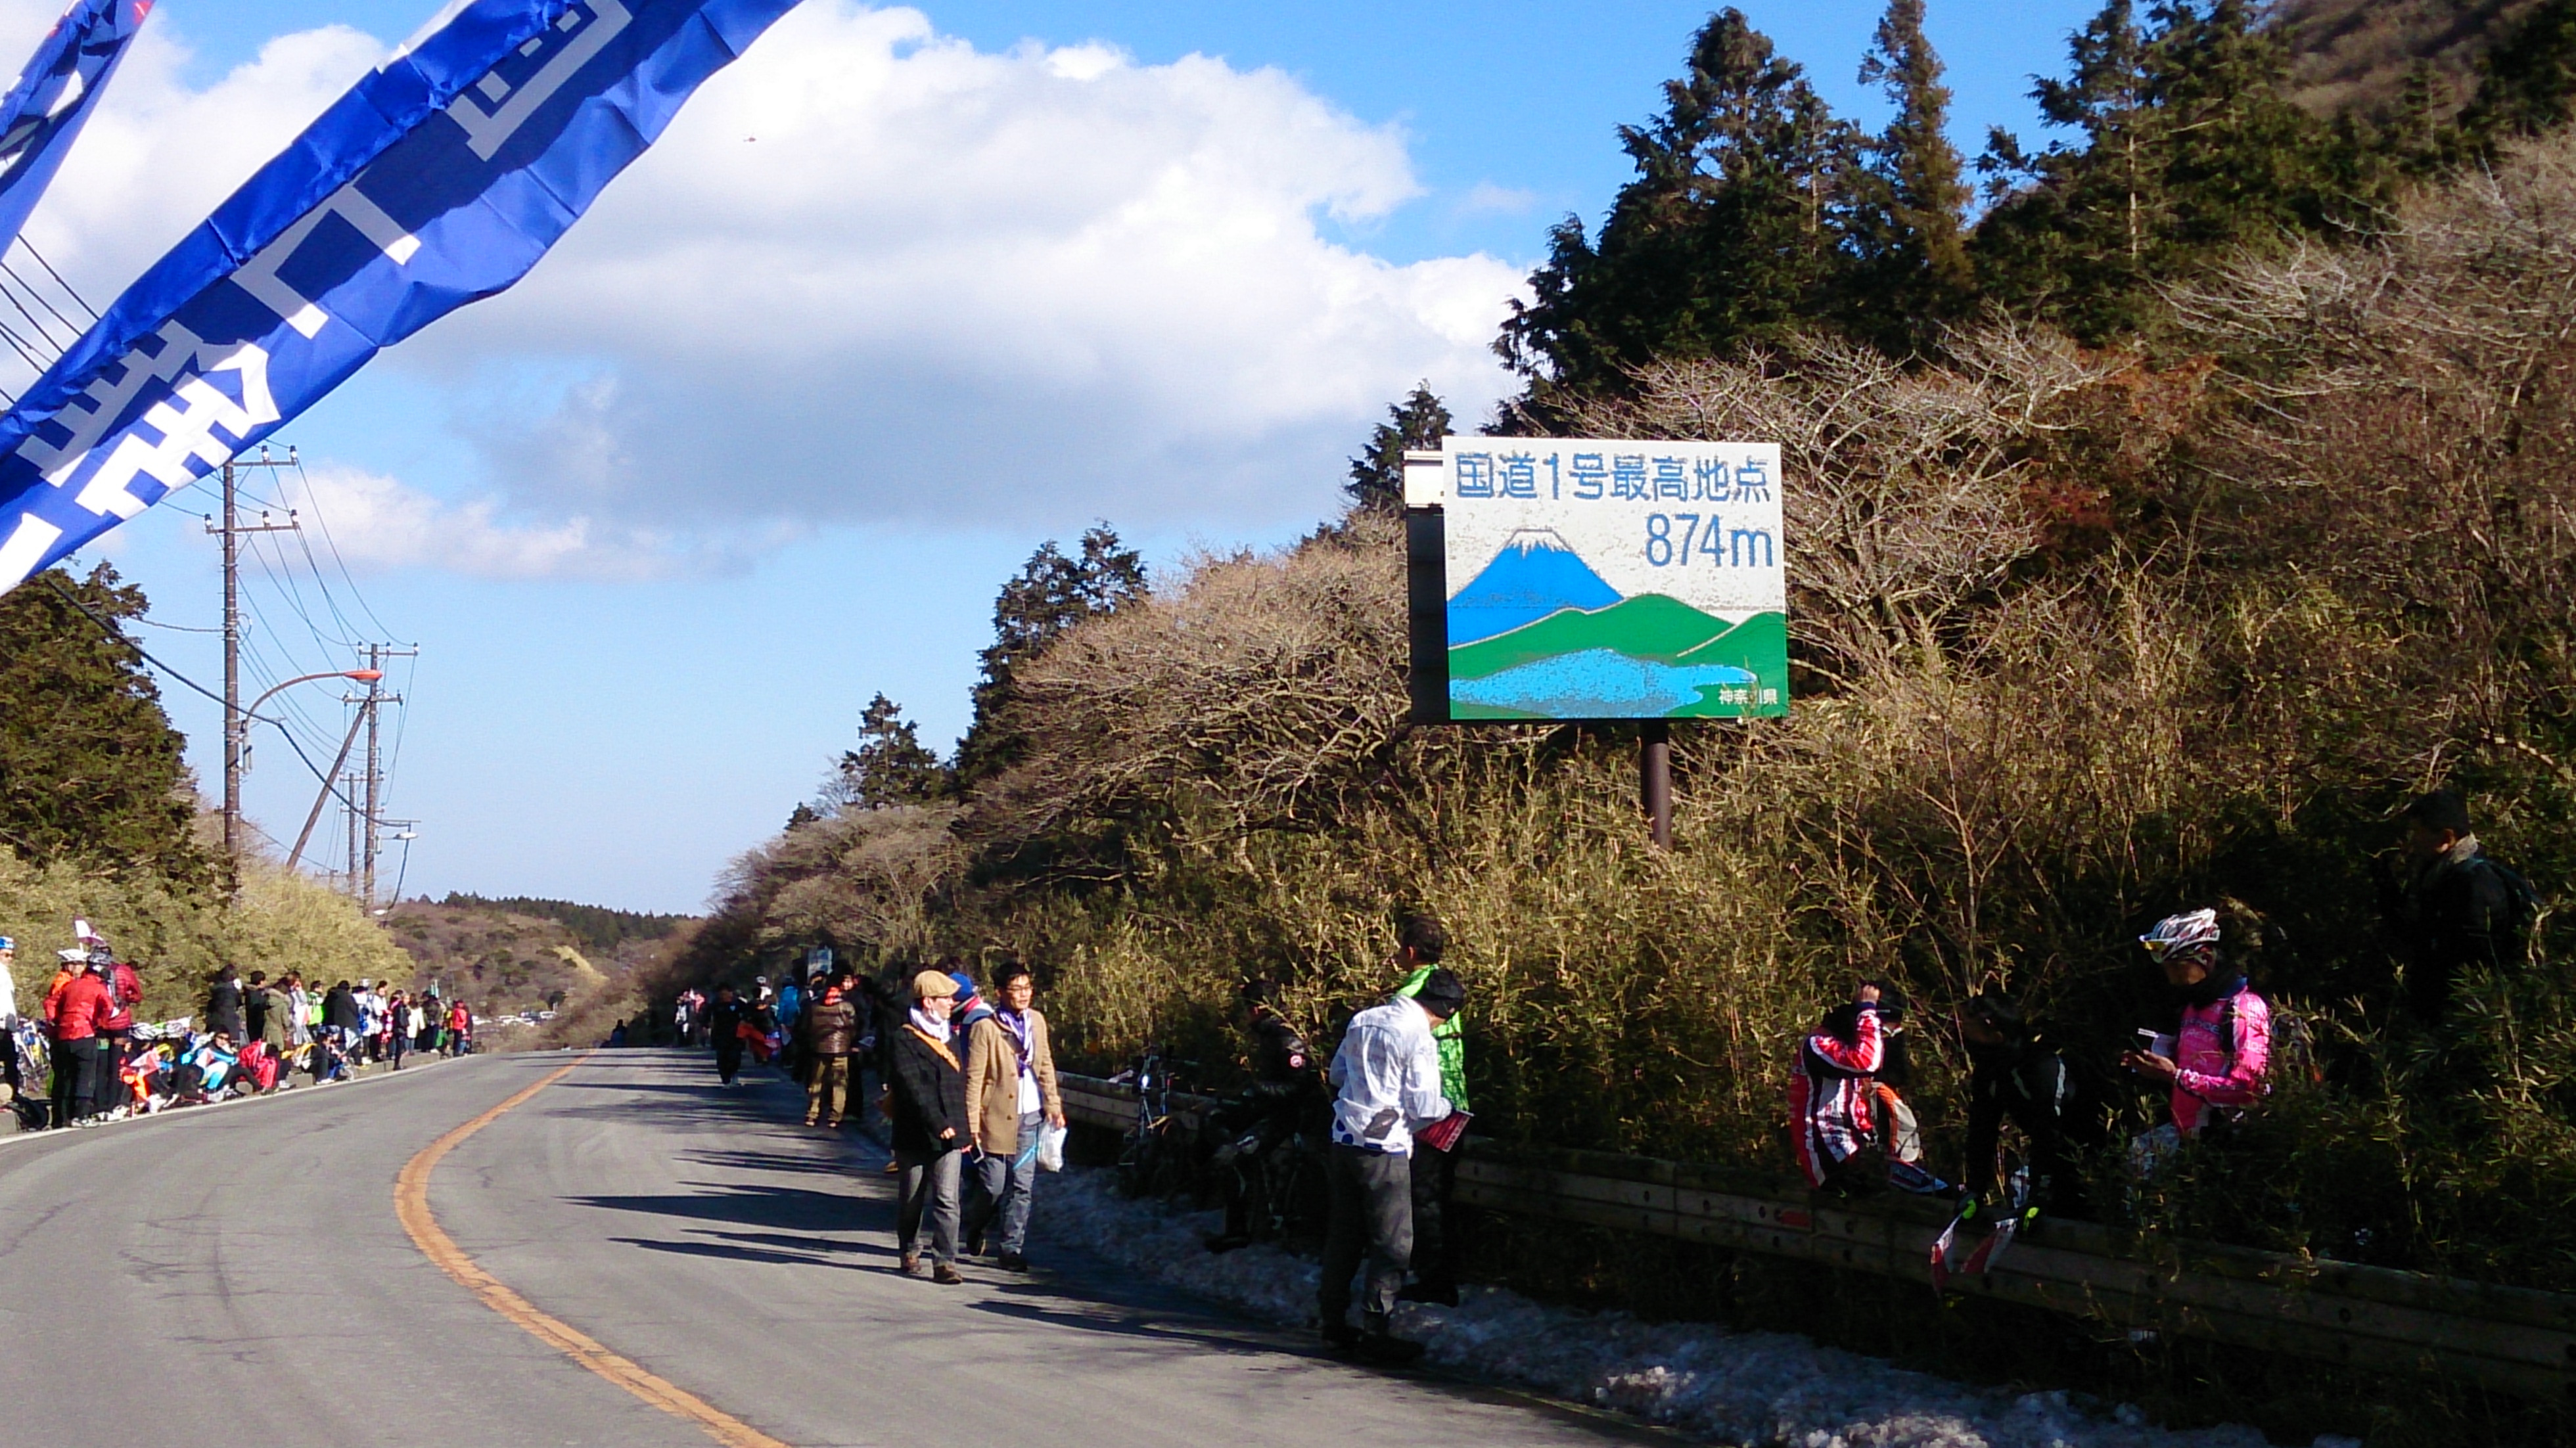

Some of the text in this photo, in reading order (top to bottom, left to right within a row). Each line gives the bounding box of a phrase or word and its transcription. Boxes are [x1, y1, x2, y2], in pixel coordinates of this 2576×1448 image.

[1456, 450, 1770, 503] 国道1号最高地点
[1645, 513, 1773, 567] 874m
